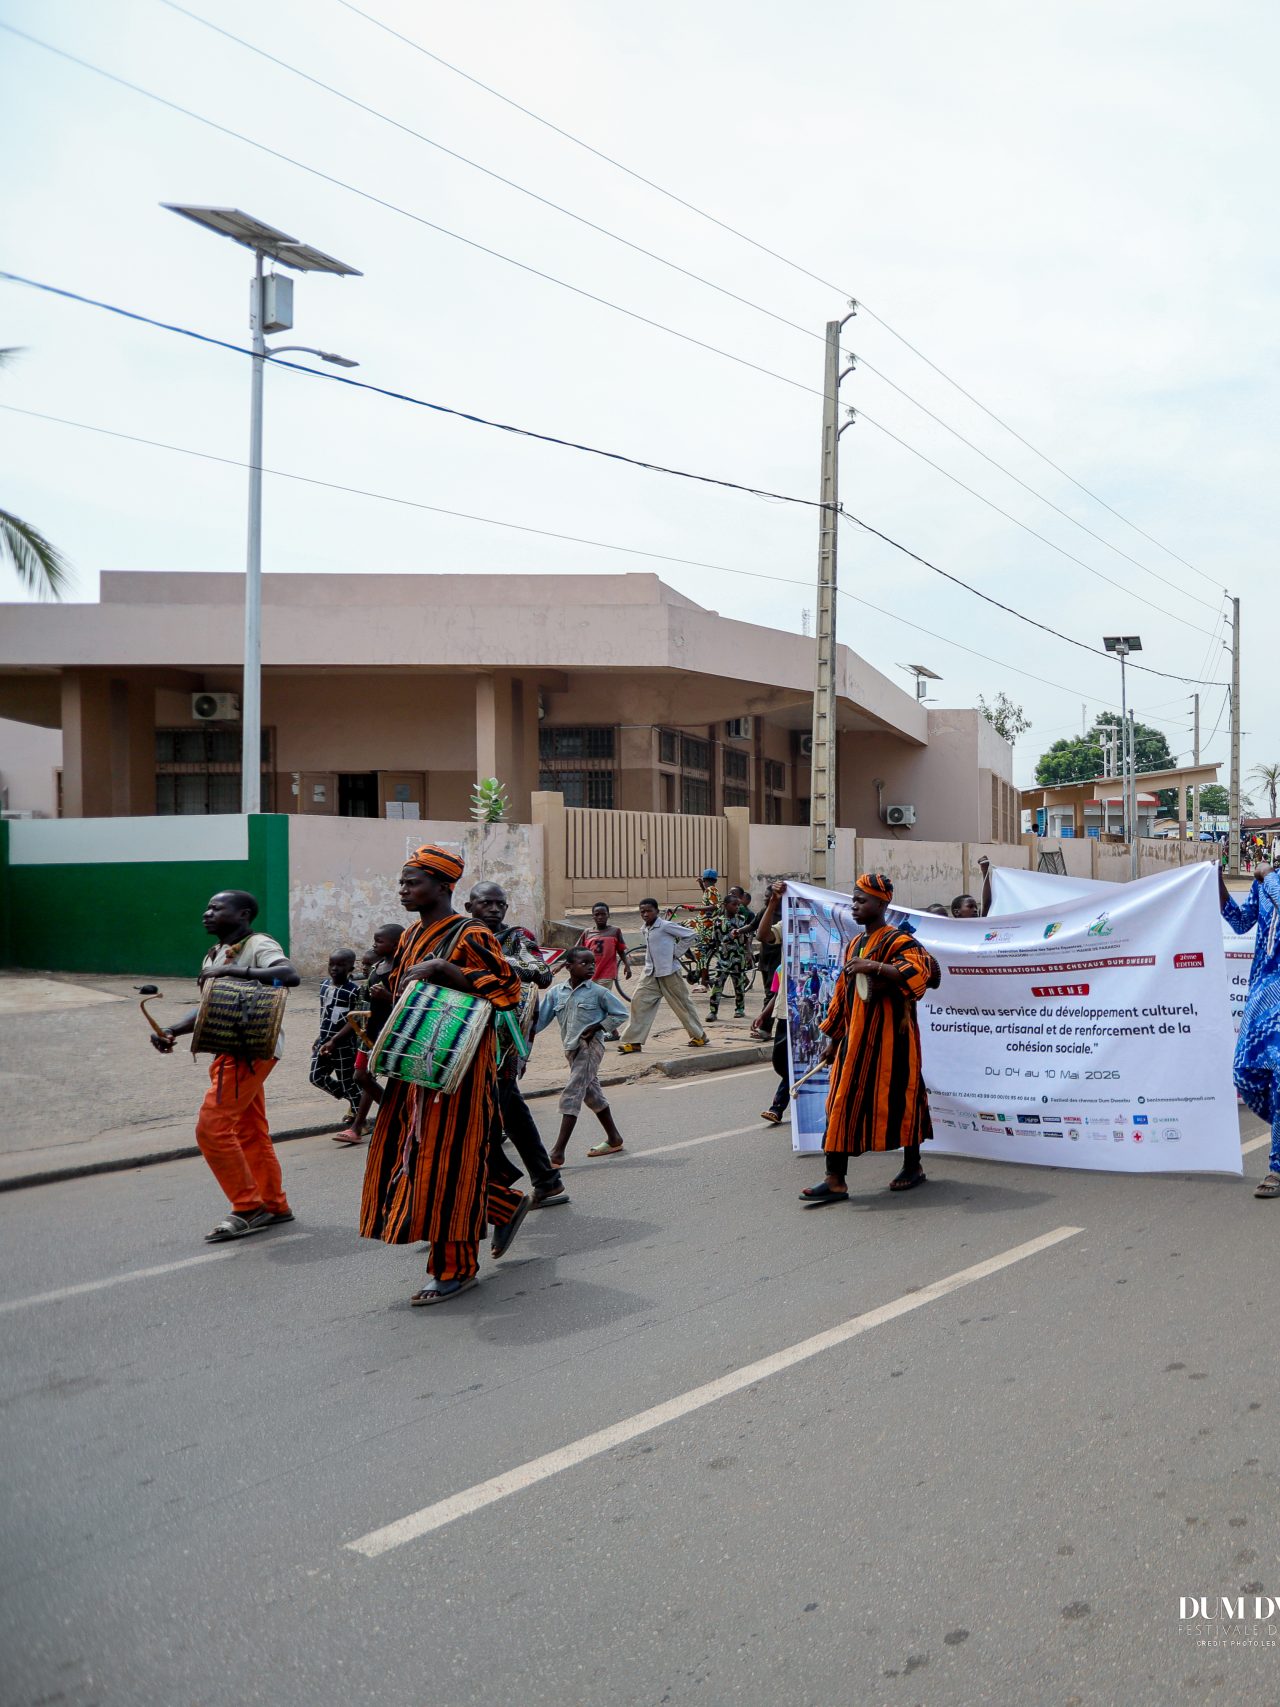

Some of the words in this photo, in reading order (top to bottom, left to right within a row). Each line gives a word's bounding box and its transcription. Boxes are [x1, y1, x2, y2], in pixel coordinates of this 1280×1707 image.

[594, 940, 604, 954] 3
[986, 965, 1045, 974] INTERNATIONAL
[1066, 961, 1104, 970] CHEVAUX
[945, 1005, 979, 1016] cheval
[997, 1006, 1037, 1017] service
[1039, 1006, 1053, 1017] du
[1055, 1006, 1139, 1020] développement
[1141, 1003, 1198, 1017] culturel,
[931, 1021, 993, 1036] touristique,
[995, 1023, 1044, 1035] artisanal
[1046, 1025, 1057, 1035] et
[1059, 1024, 1072, 1035] de
[1074, 1024, 1155, 1036] renforcement
[1158, 1022, 1175, 1034] de
[1178, 1022, 1191, 1033] la
[1006, 1041, 1053, 1053] cohésion
[985, 1066, 1000, 1076] Du
[1005, 1067, 1020, 1077] 04
[1024, 1070, 1039, 1078] au
[1045, 1069, 1056, 1079] 10
[1060, 1069, 1080, 1080] Mai
[1084, 1070, 1121, 1080] 2026
